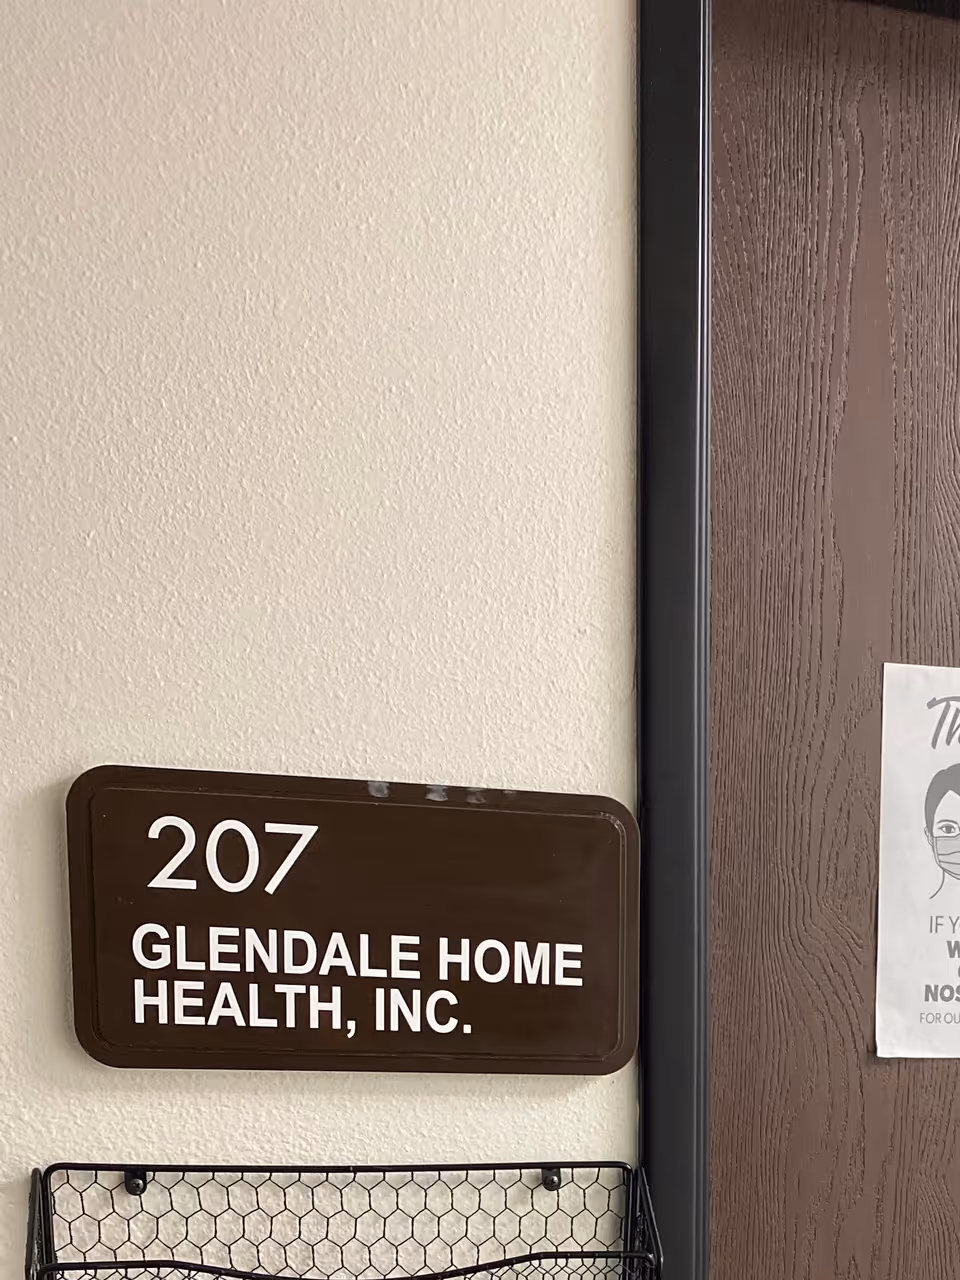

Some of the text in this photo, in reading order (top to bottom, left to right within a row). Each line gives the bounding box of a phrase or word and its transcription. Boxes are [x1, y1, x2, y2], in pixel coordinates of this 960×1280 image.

[147, 815, 319, 895] 207
[131, 922, 584, 987] GLENDALE HOME
[929, 915, 944, 935] IF
[133, 978, 472, 1039] HEALTH, INC.
[919, 1012, 942, 1025] FOR
